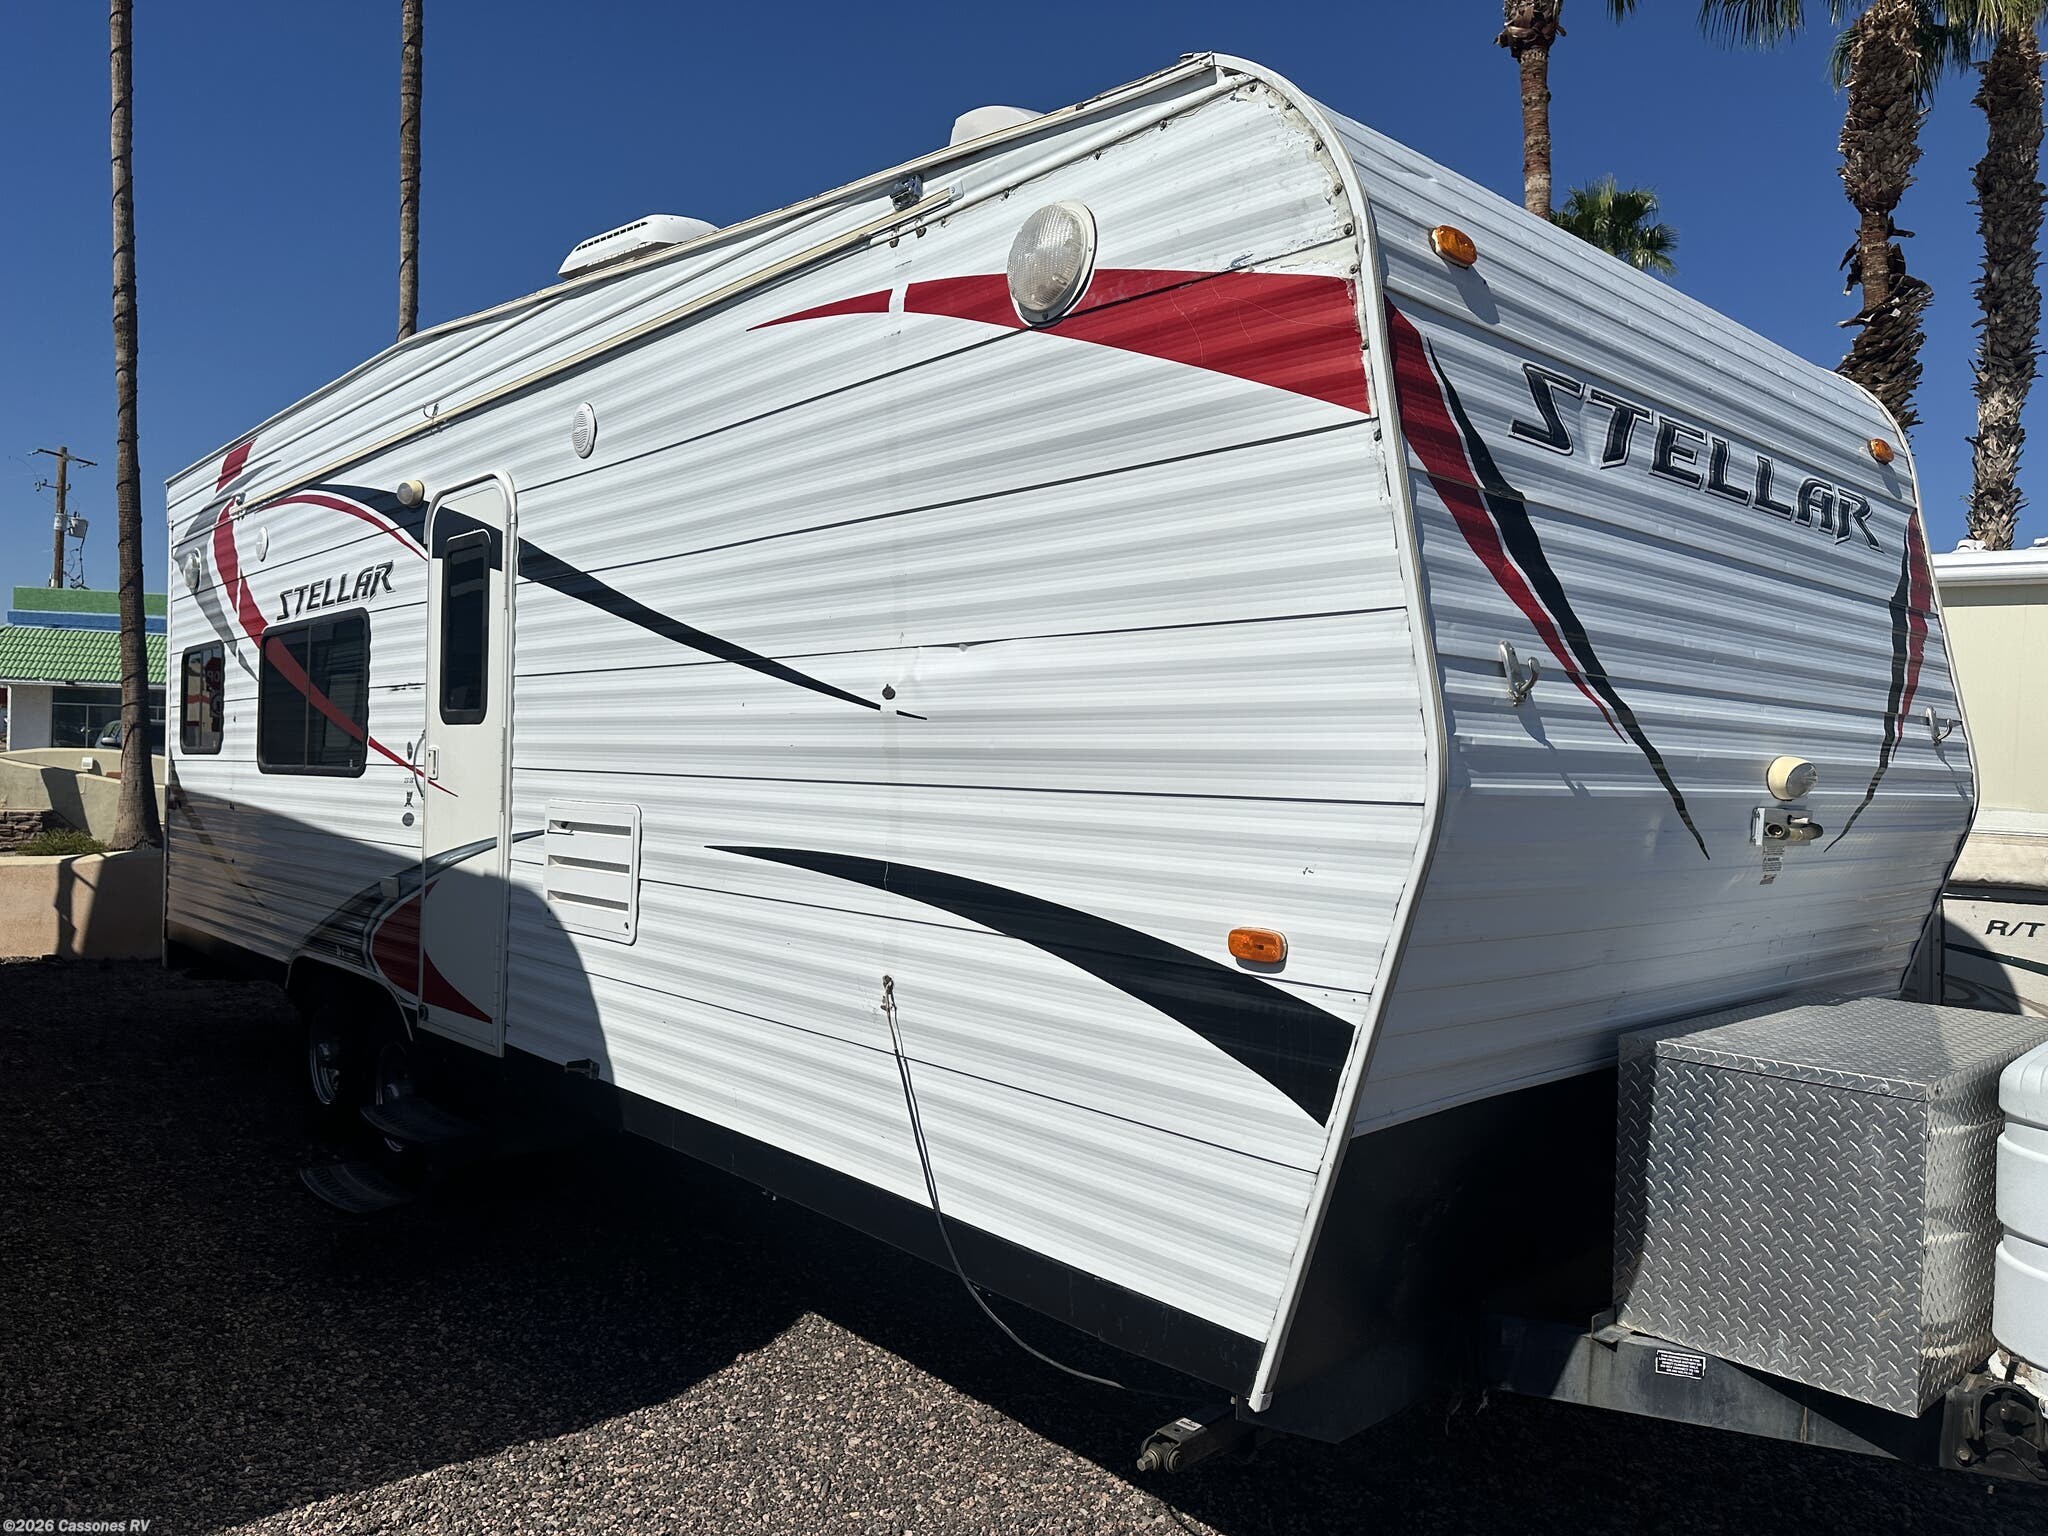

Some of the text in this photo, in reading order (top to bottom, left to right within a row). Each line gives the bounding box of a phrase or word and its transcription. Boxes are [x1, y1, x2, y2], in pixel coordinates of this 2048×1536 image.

[1508, 362, 1884, 553] STELLAR
[276, 559, 396, 623] STELLAR
[1985, 919, 2046, 938] R/T
